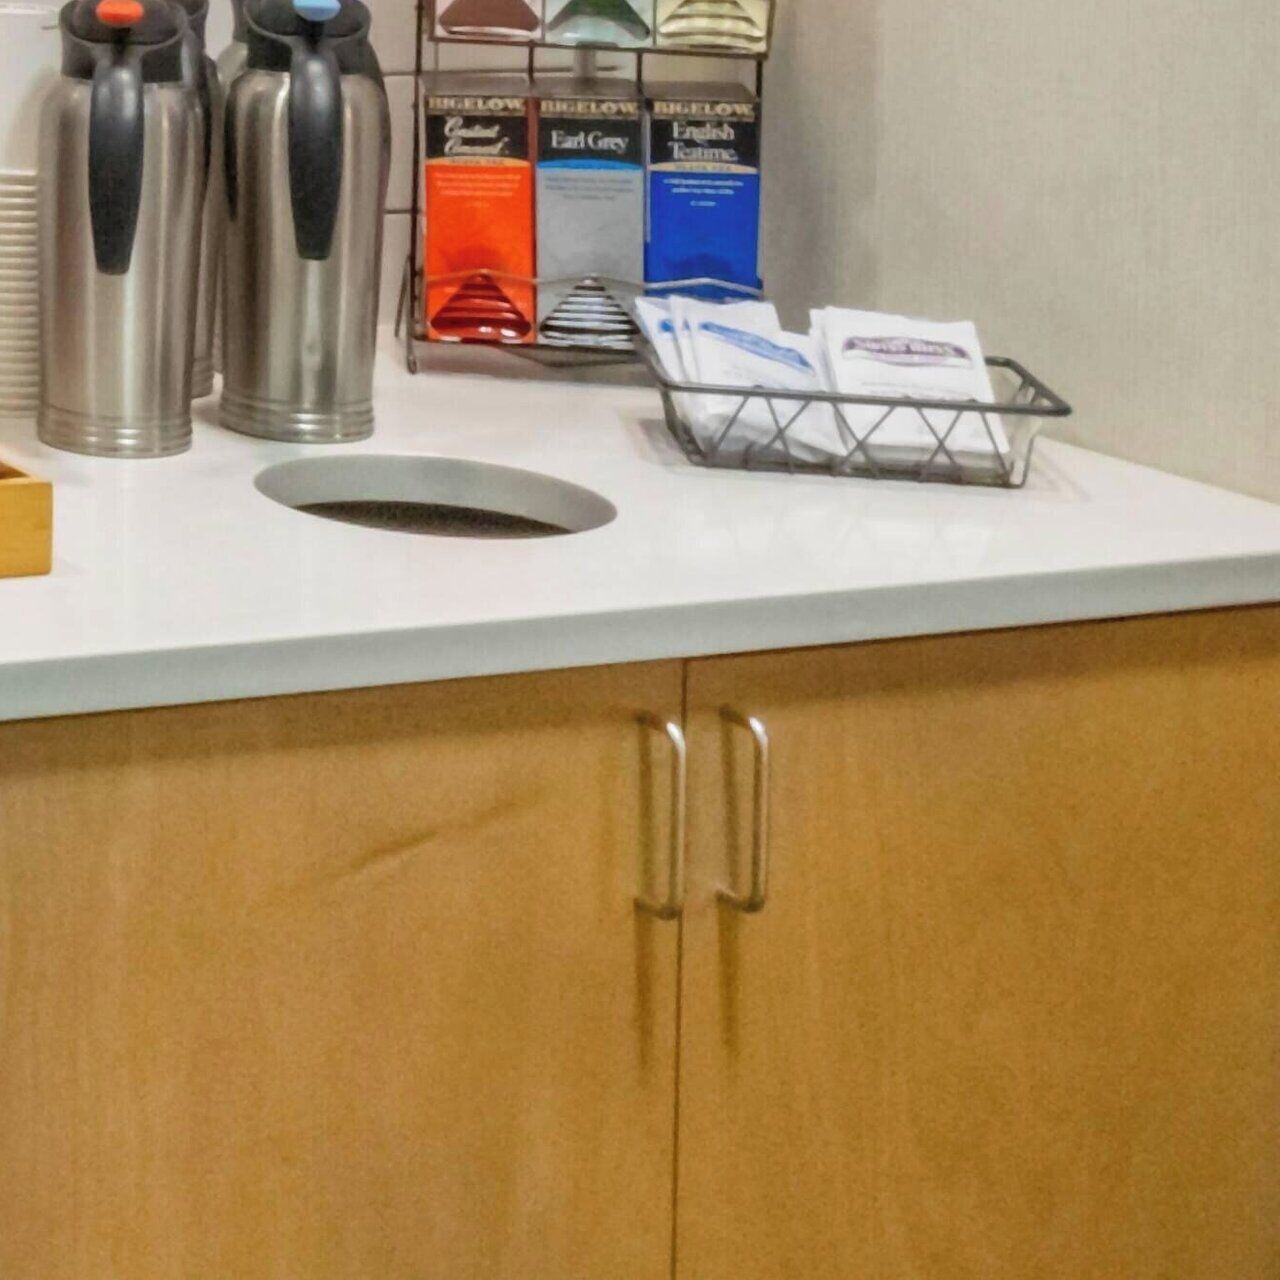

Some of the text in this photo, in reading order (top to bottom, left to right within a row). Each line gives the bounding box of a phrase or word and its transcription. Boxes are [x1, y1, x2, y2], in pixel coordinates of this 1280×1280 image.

[428, 96, 523, 111] BIGELOW
[541, 100, 638, 114] BIGELOW
[653, 101, 753, 116] BIGELOW
[672, 120, 735, 146] English
[551, 129, 629, 154] Earl Grey
